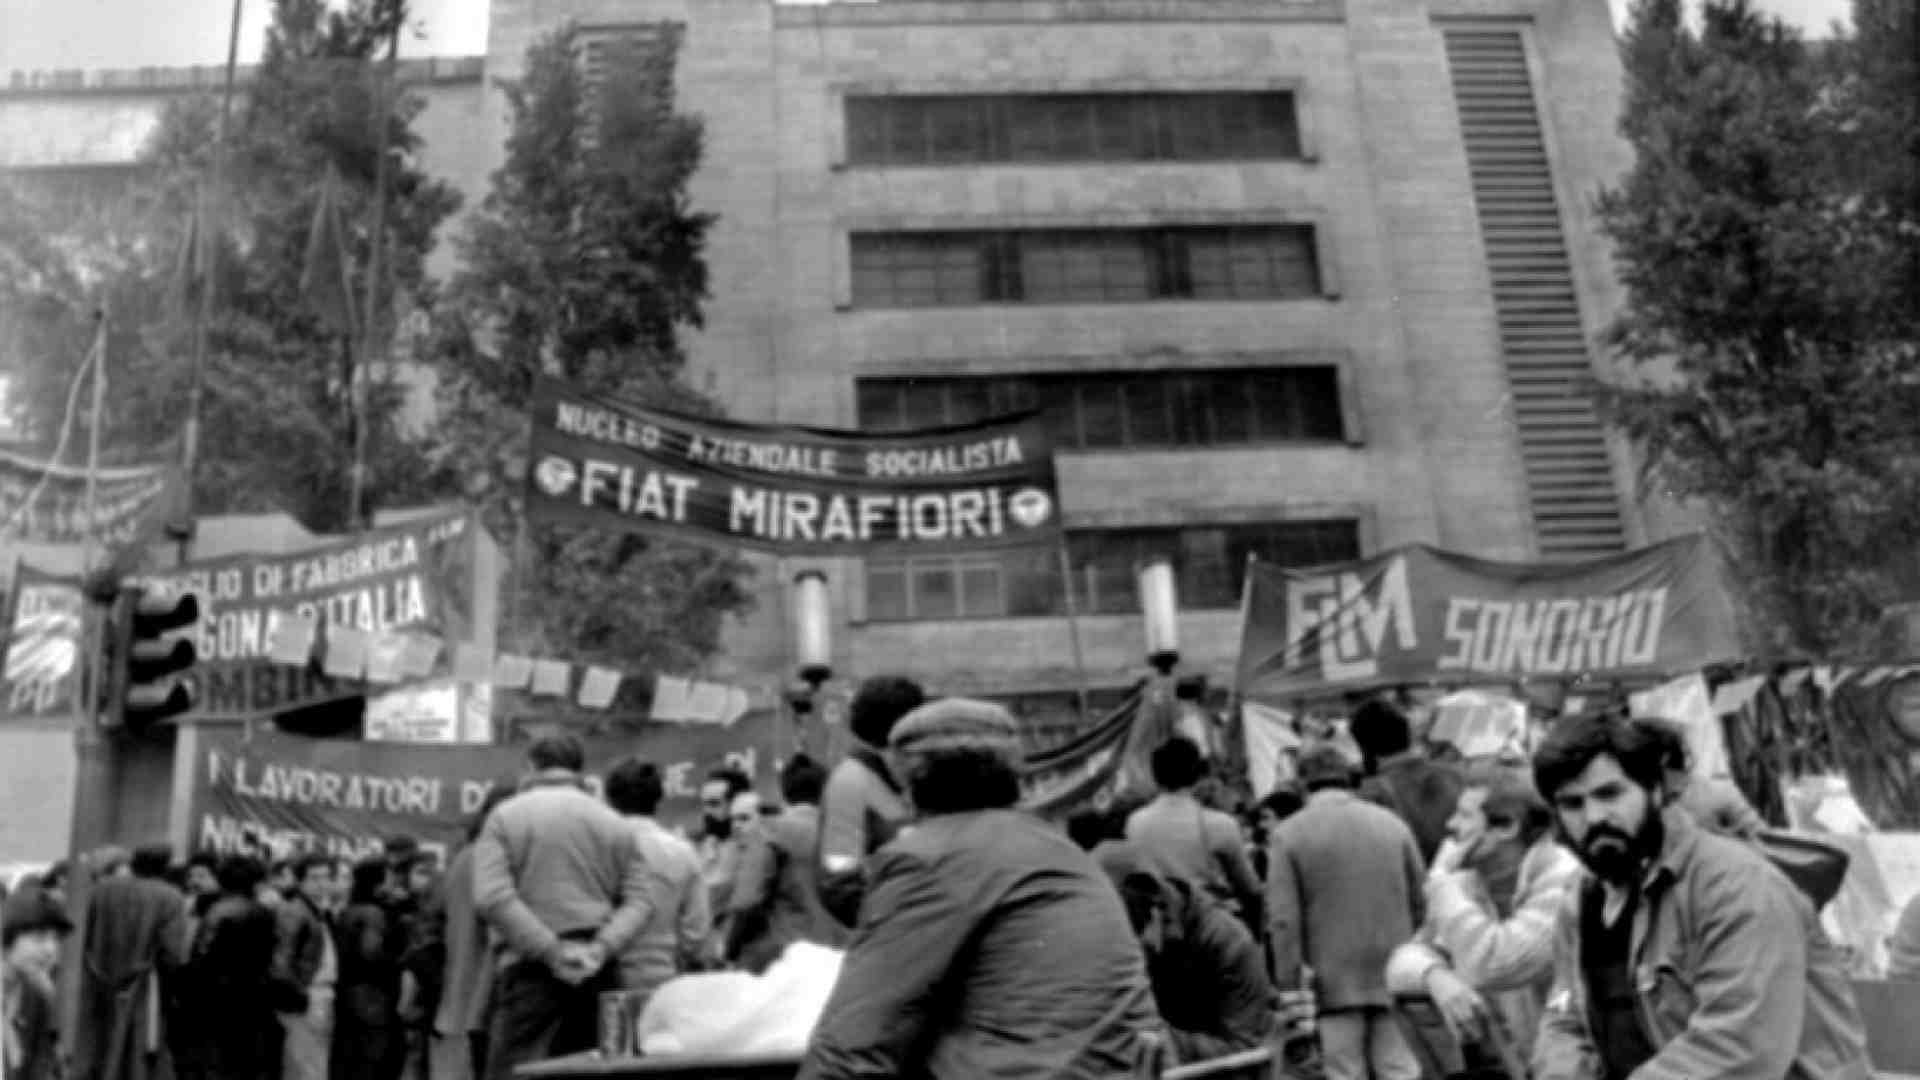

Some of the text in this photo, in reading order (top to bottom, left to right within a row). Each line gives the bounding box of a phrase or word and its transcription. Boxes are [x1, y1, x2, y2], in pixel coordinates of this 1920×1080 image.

[556, 402, 1023, 478] NUCLEO AZIENDALE SOCIALISTA
[580, 459, 1003, 541] FIAT MIRAFIORI
[254, 564, 283, 597] DI
[234, 757, 442, 815] LAVORATORI
